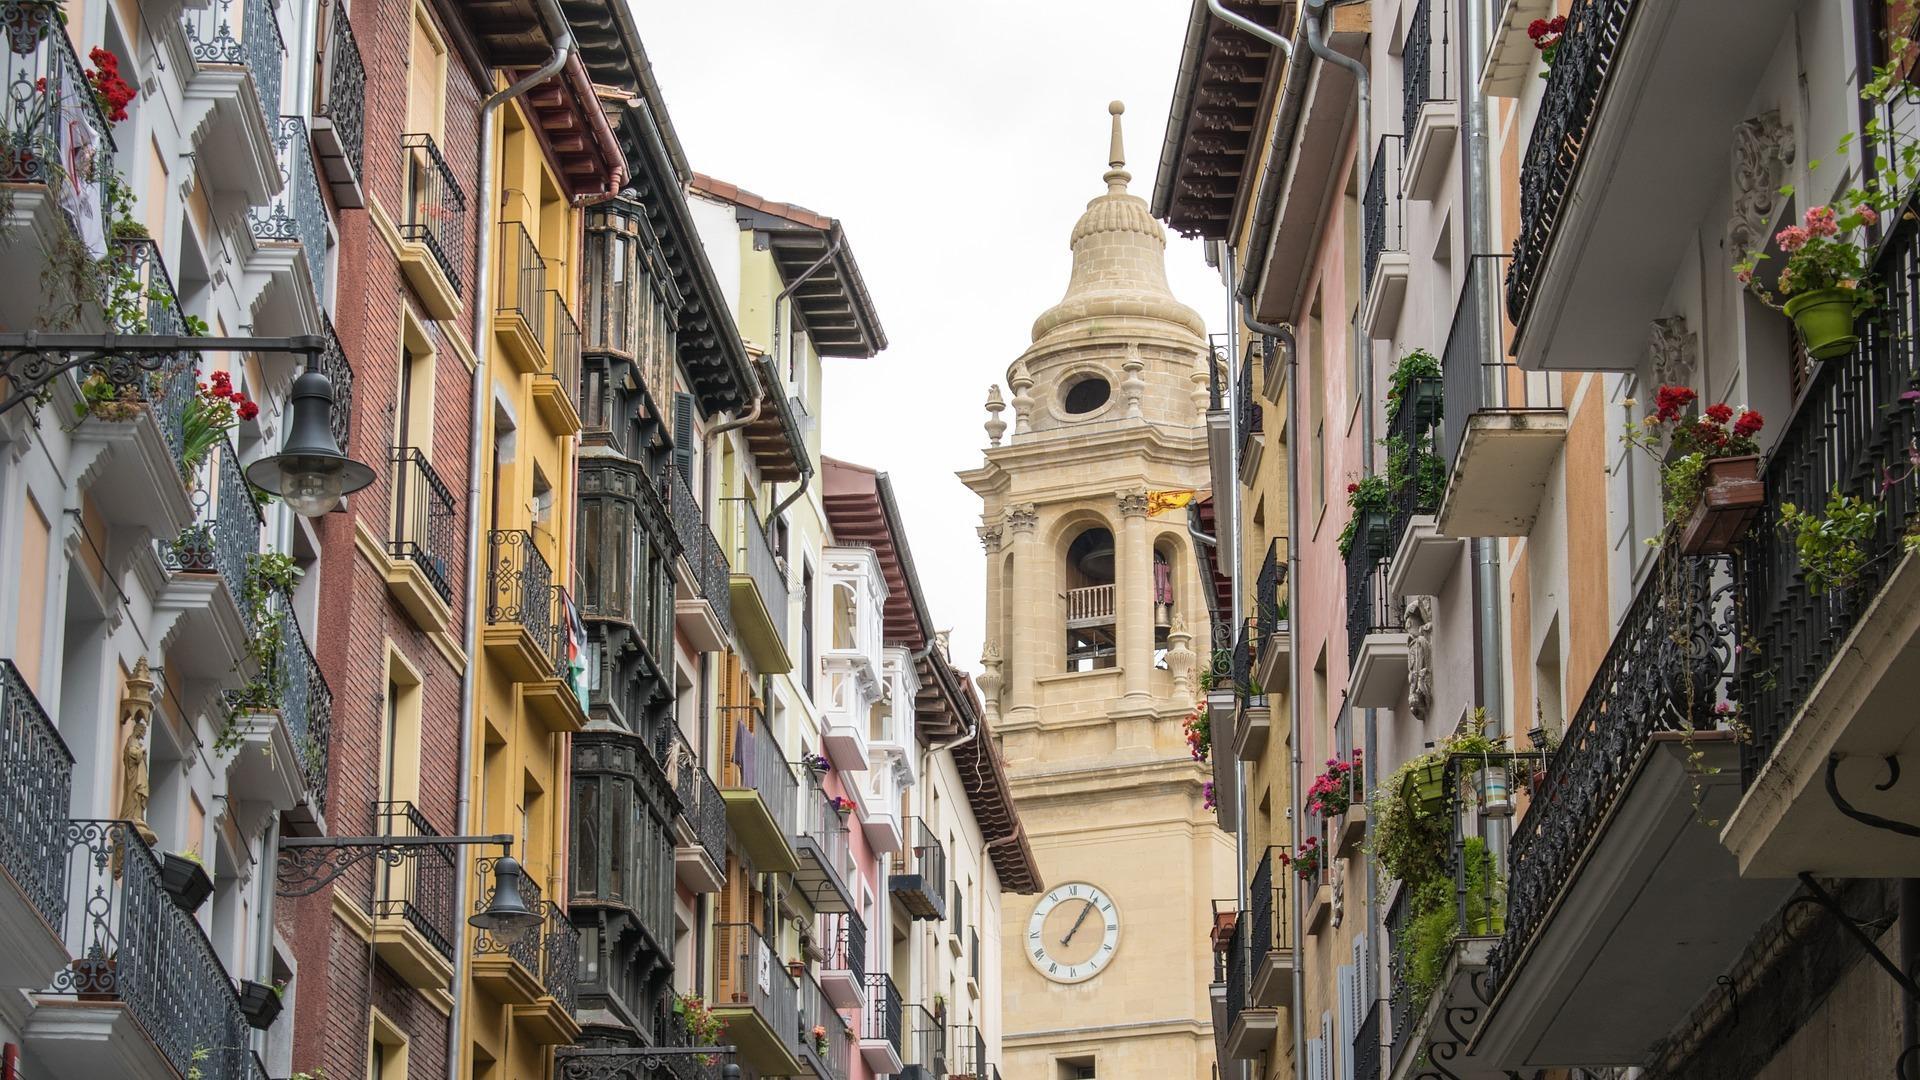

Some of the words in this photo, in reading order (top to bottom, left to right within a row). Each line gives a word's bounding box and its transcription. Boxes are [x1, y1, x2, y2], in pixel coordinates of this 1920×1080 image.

[1068, 885, 1077, 896] XII
[1049, 892, 1058, 903] XI
[1102, 903, 1111, 912] II
